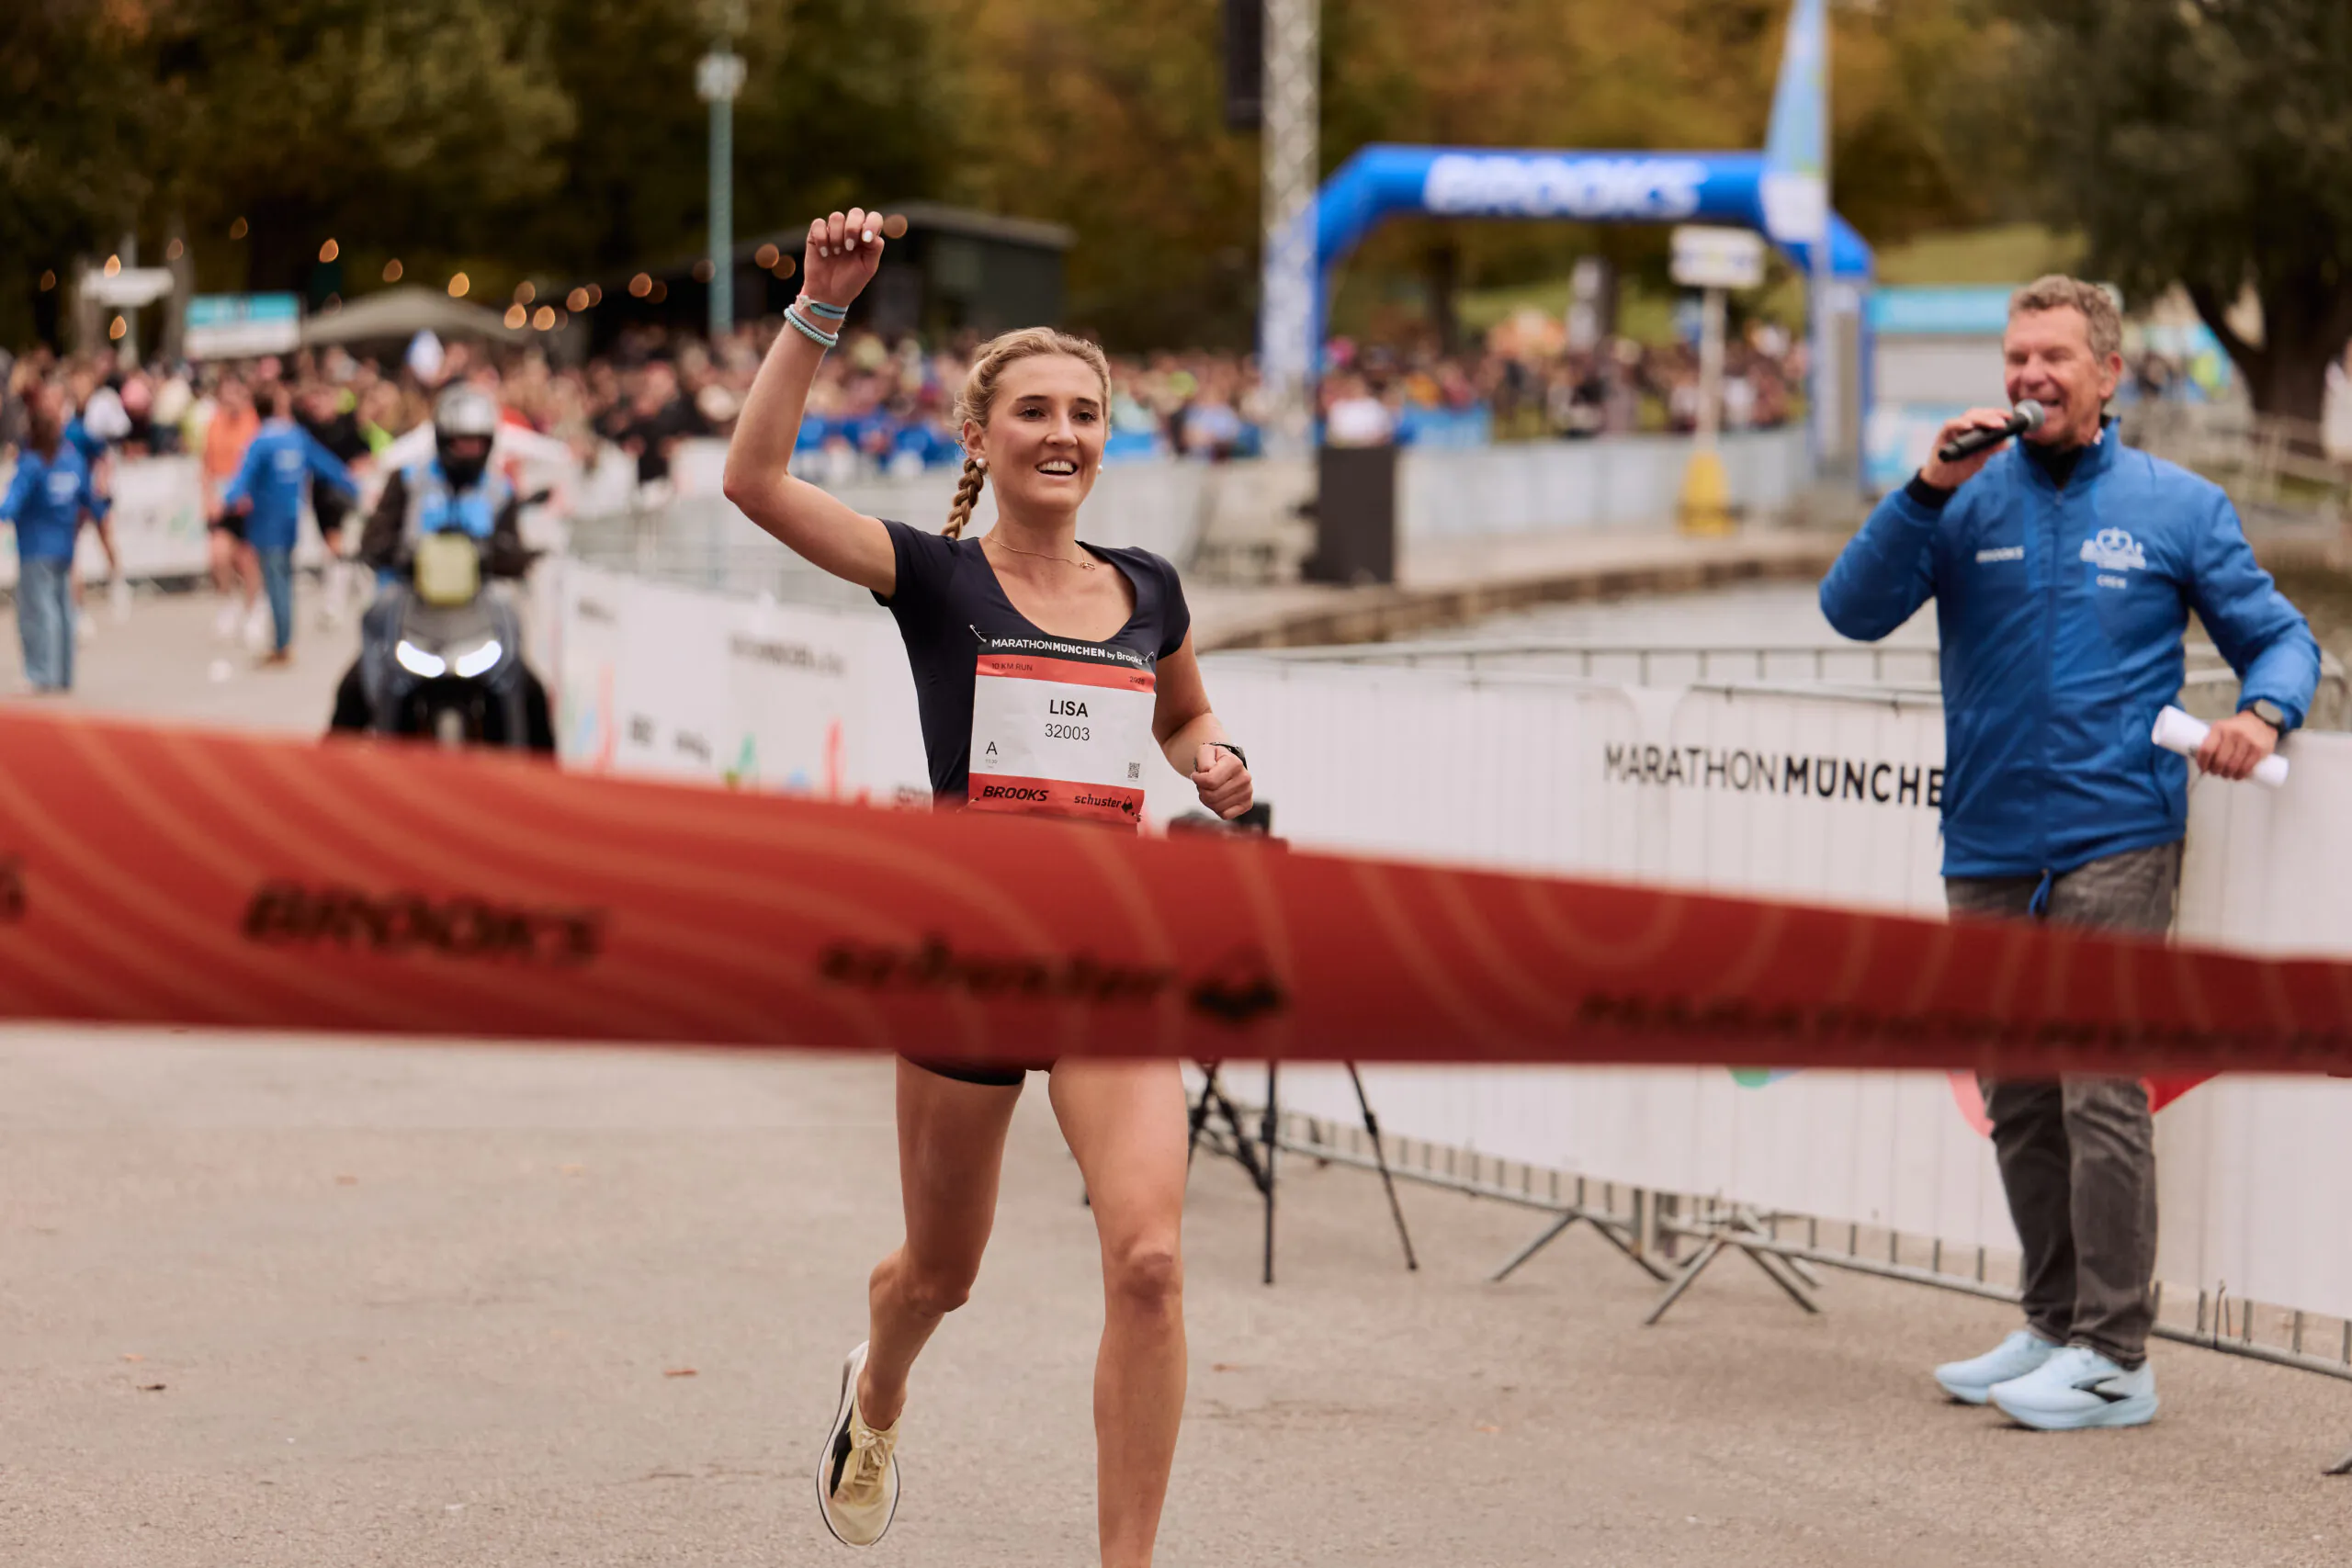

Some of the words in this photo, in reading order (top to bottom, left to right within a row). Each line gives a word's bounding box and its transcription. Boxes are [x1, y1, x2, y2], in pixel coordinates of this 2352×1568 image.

[991, 638, 1105, 658] MARATHONMÜNCHEN
[1106, 651, 1115, 660] by
[1116, 651, 1143, 666] Brooks
[1015, 663, 1033, 671] RUN
[1048, 699, 1089, 718] LISA
[1045, 723, 1091, 741] 32003
[985, 741, 998, 755] A
[1604, 742, 1946, 808] MARATHONMÜNCHE
[982, 785, 1050, 802] BROOKS
[1074, 793, 1123, 808] schuster
